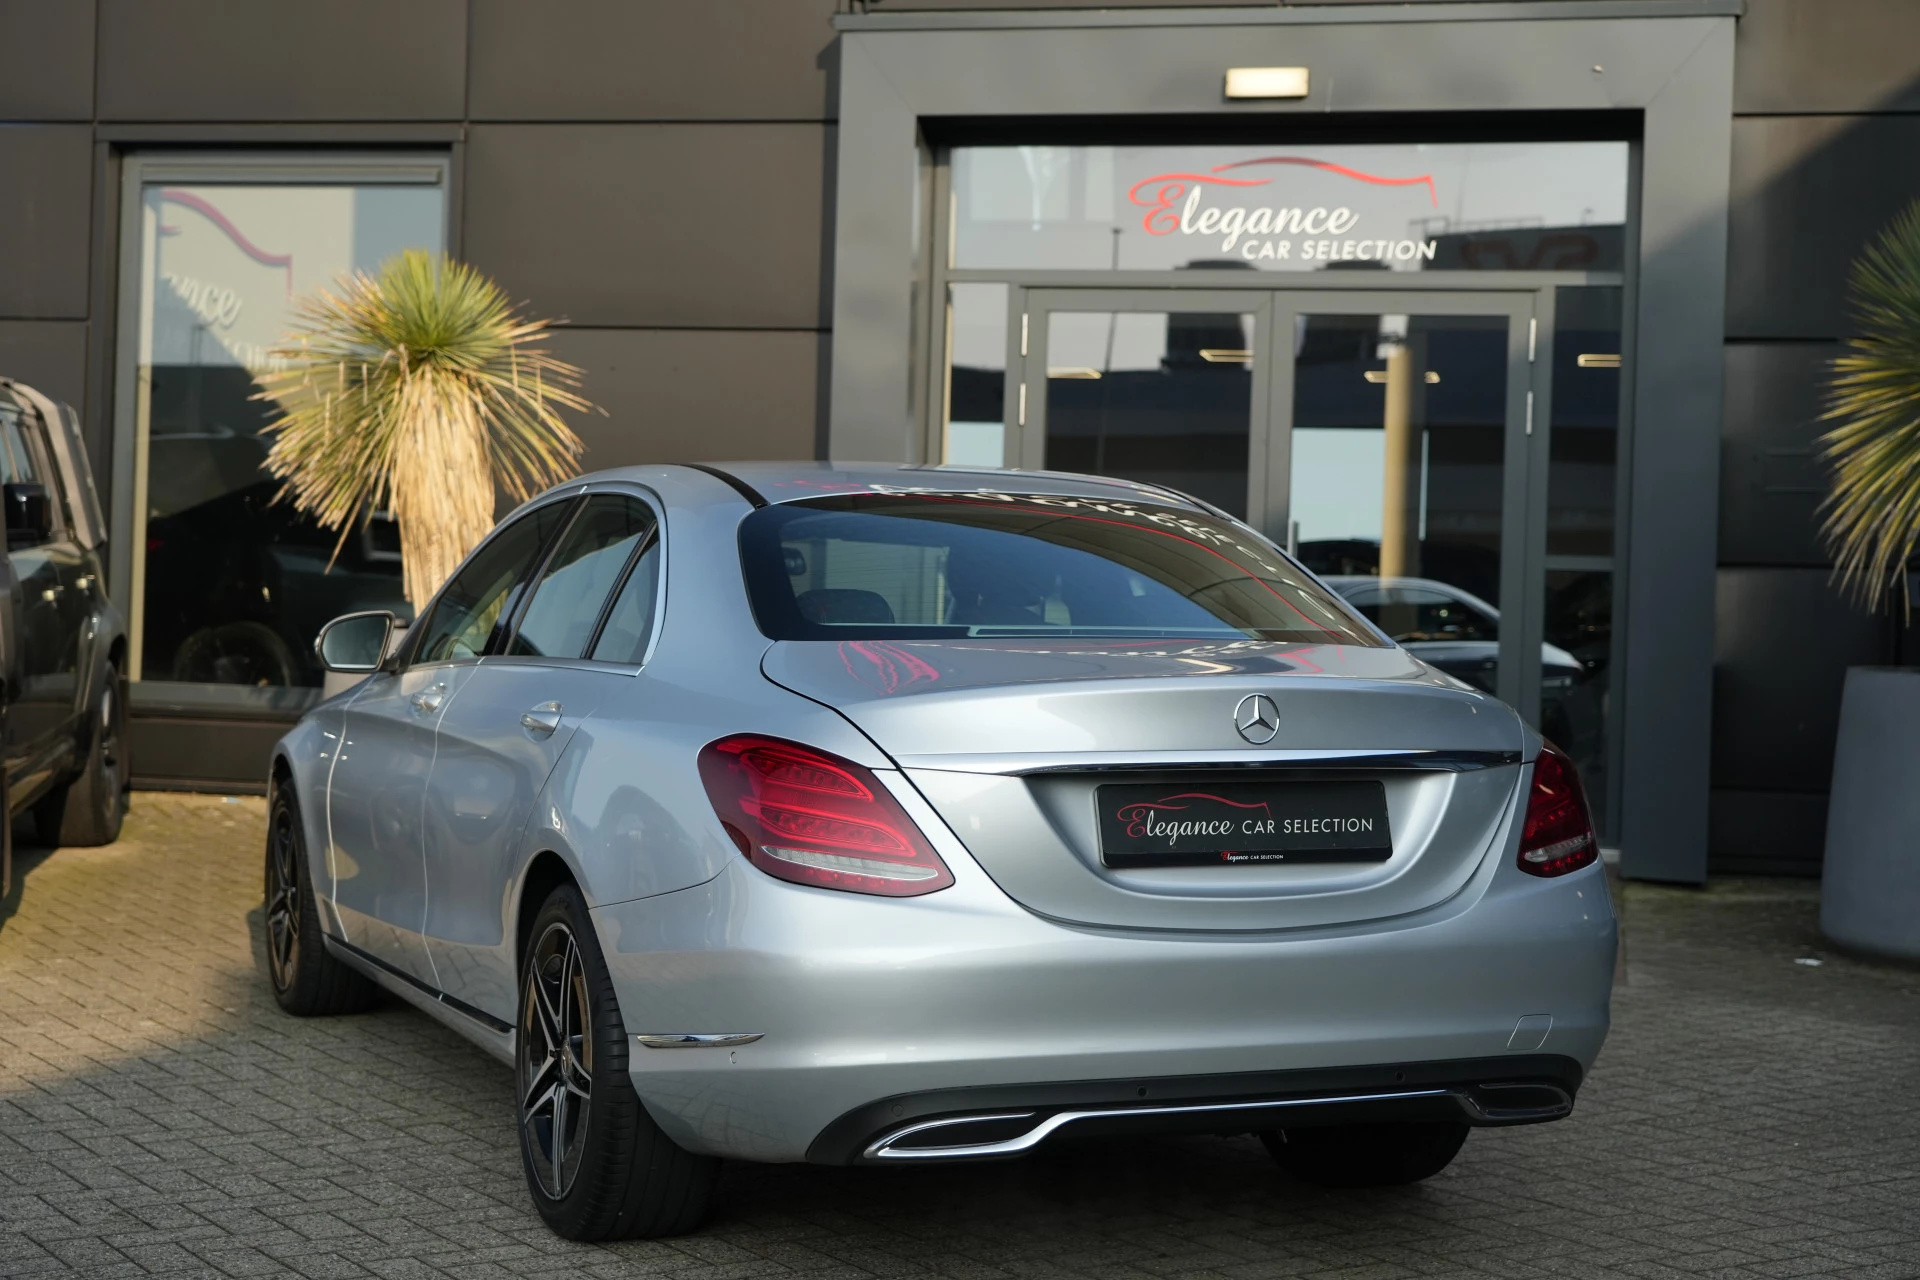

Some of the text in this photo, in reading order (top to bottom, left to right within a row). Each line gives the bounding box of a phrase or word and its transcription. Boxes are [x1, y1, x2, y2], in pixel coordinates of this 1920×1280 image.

[1128, 173, 1359, 252] Elegance
[1241, 239, 1291, 261] CAR
[1300, 239, 1438, 262] SELECTION
[1117, 802, 1374, 846] Elegance CAR SELECTION
[1221, 851, 1249, 862] Elegance
